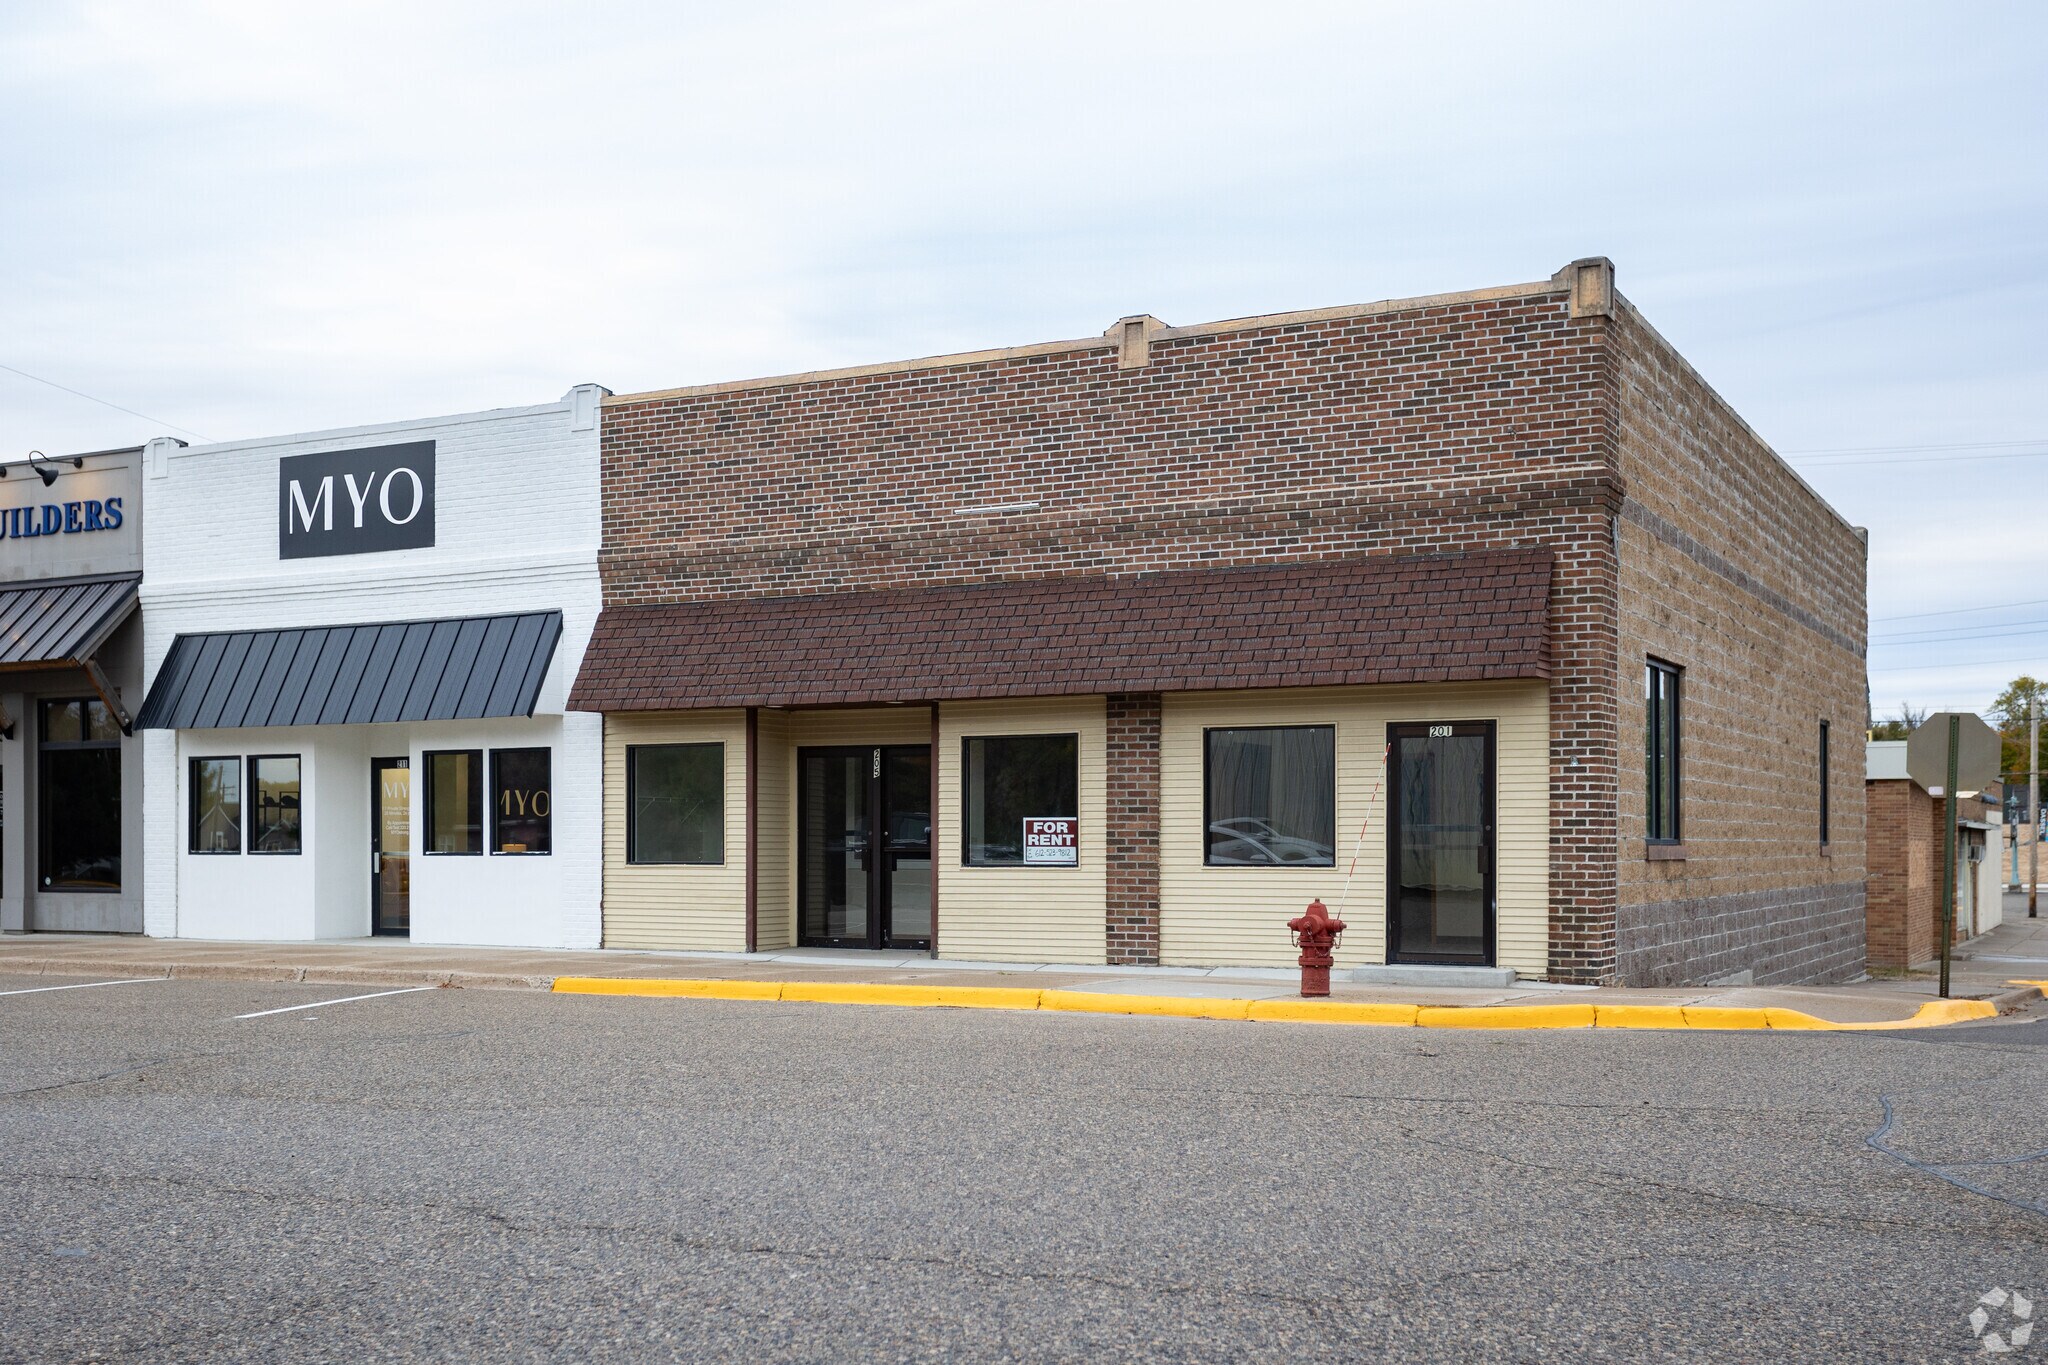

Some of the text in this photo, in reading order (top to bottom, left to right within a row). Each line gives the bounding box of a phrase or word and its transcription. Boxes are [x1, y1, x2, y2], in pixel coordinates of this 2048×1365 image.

[289, 467, 423, 534] MYO
[1431, 726, 1450, 736] 201
[384, 782, 409, 798] MY
[1033, 821, 1068, 833] FOR
[1028, 834, 1074, 846] RENT
